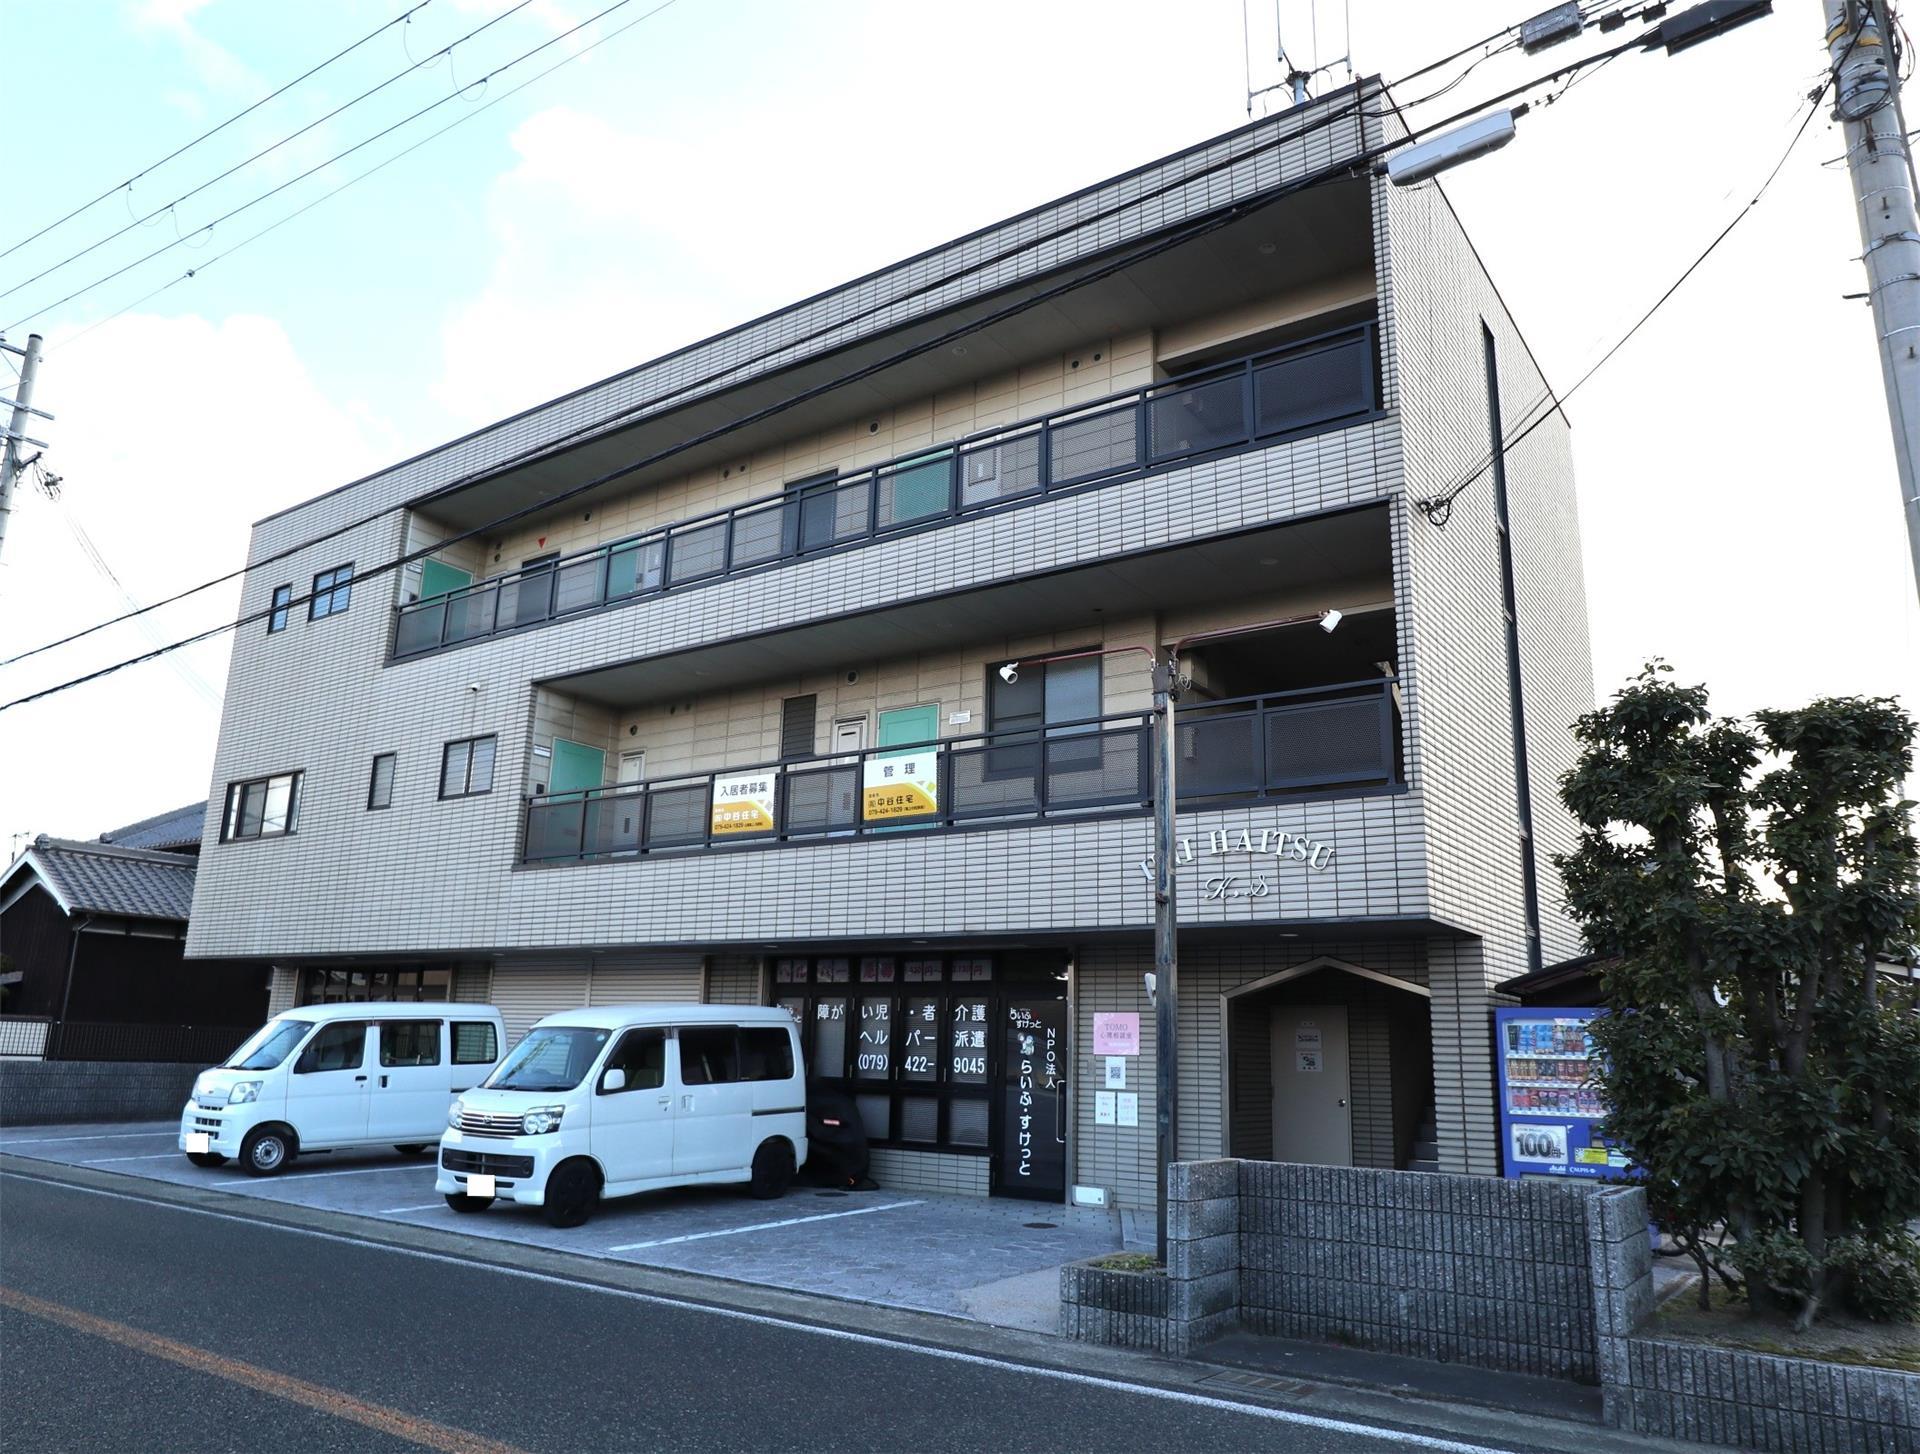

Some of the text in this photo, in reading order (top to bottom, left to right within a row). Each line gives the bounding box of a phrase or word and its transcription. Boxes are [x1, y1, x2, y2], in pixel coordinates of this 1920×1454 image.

[883, 762, 916, 778] 管理
[720, 781, 768, 797] 入居者募集
[1208, 828, 1335, 872] HAITSU
[857, 1053, 889, 1071] (079)
[953, 1056, 986, 1074] 9045
[1045, 1028, 1056, 1089] NPO法人
